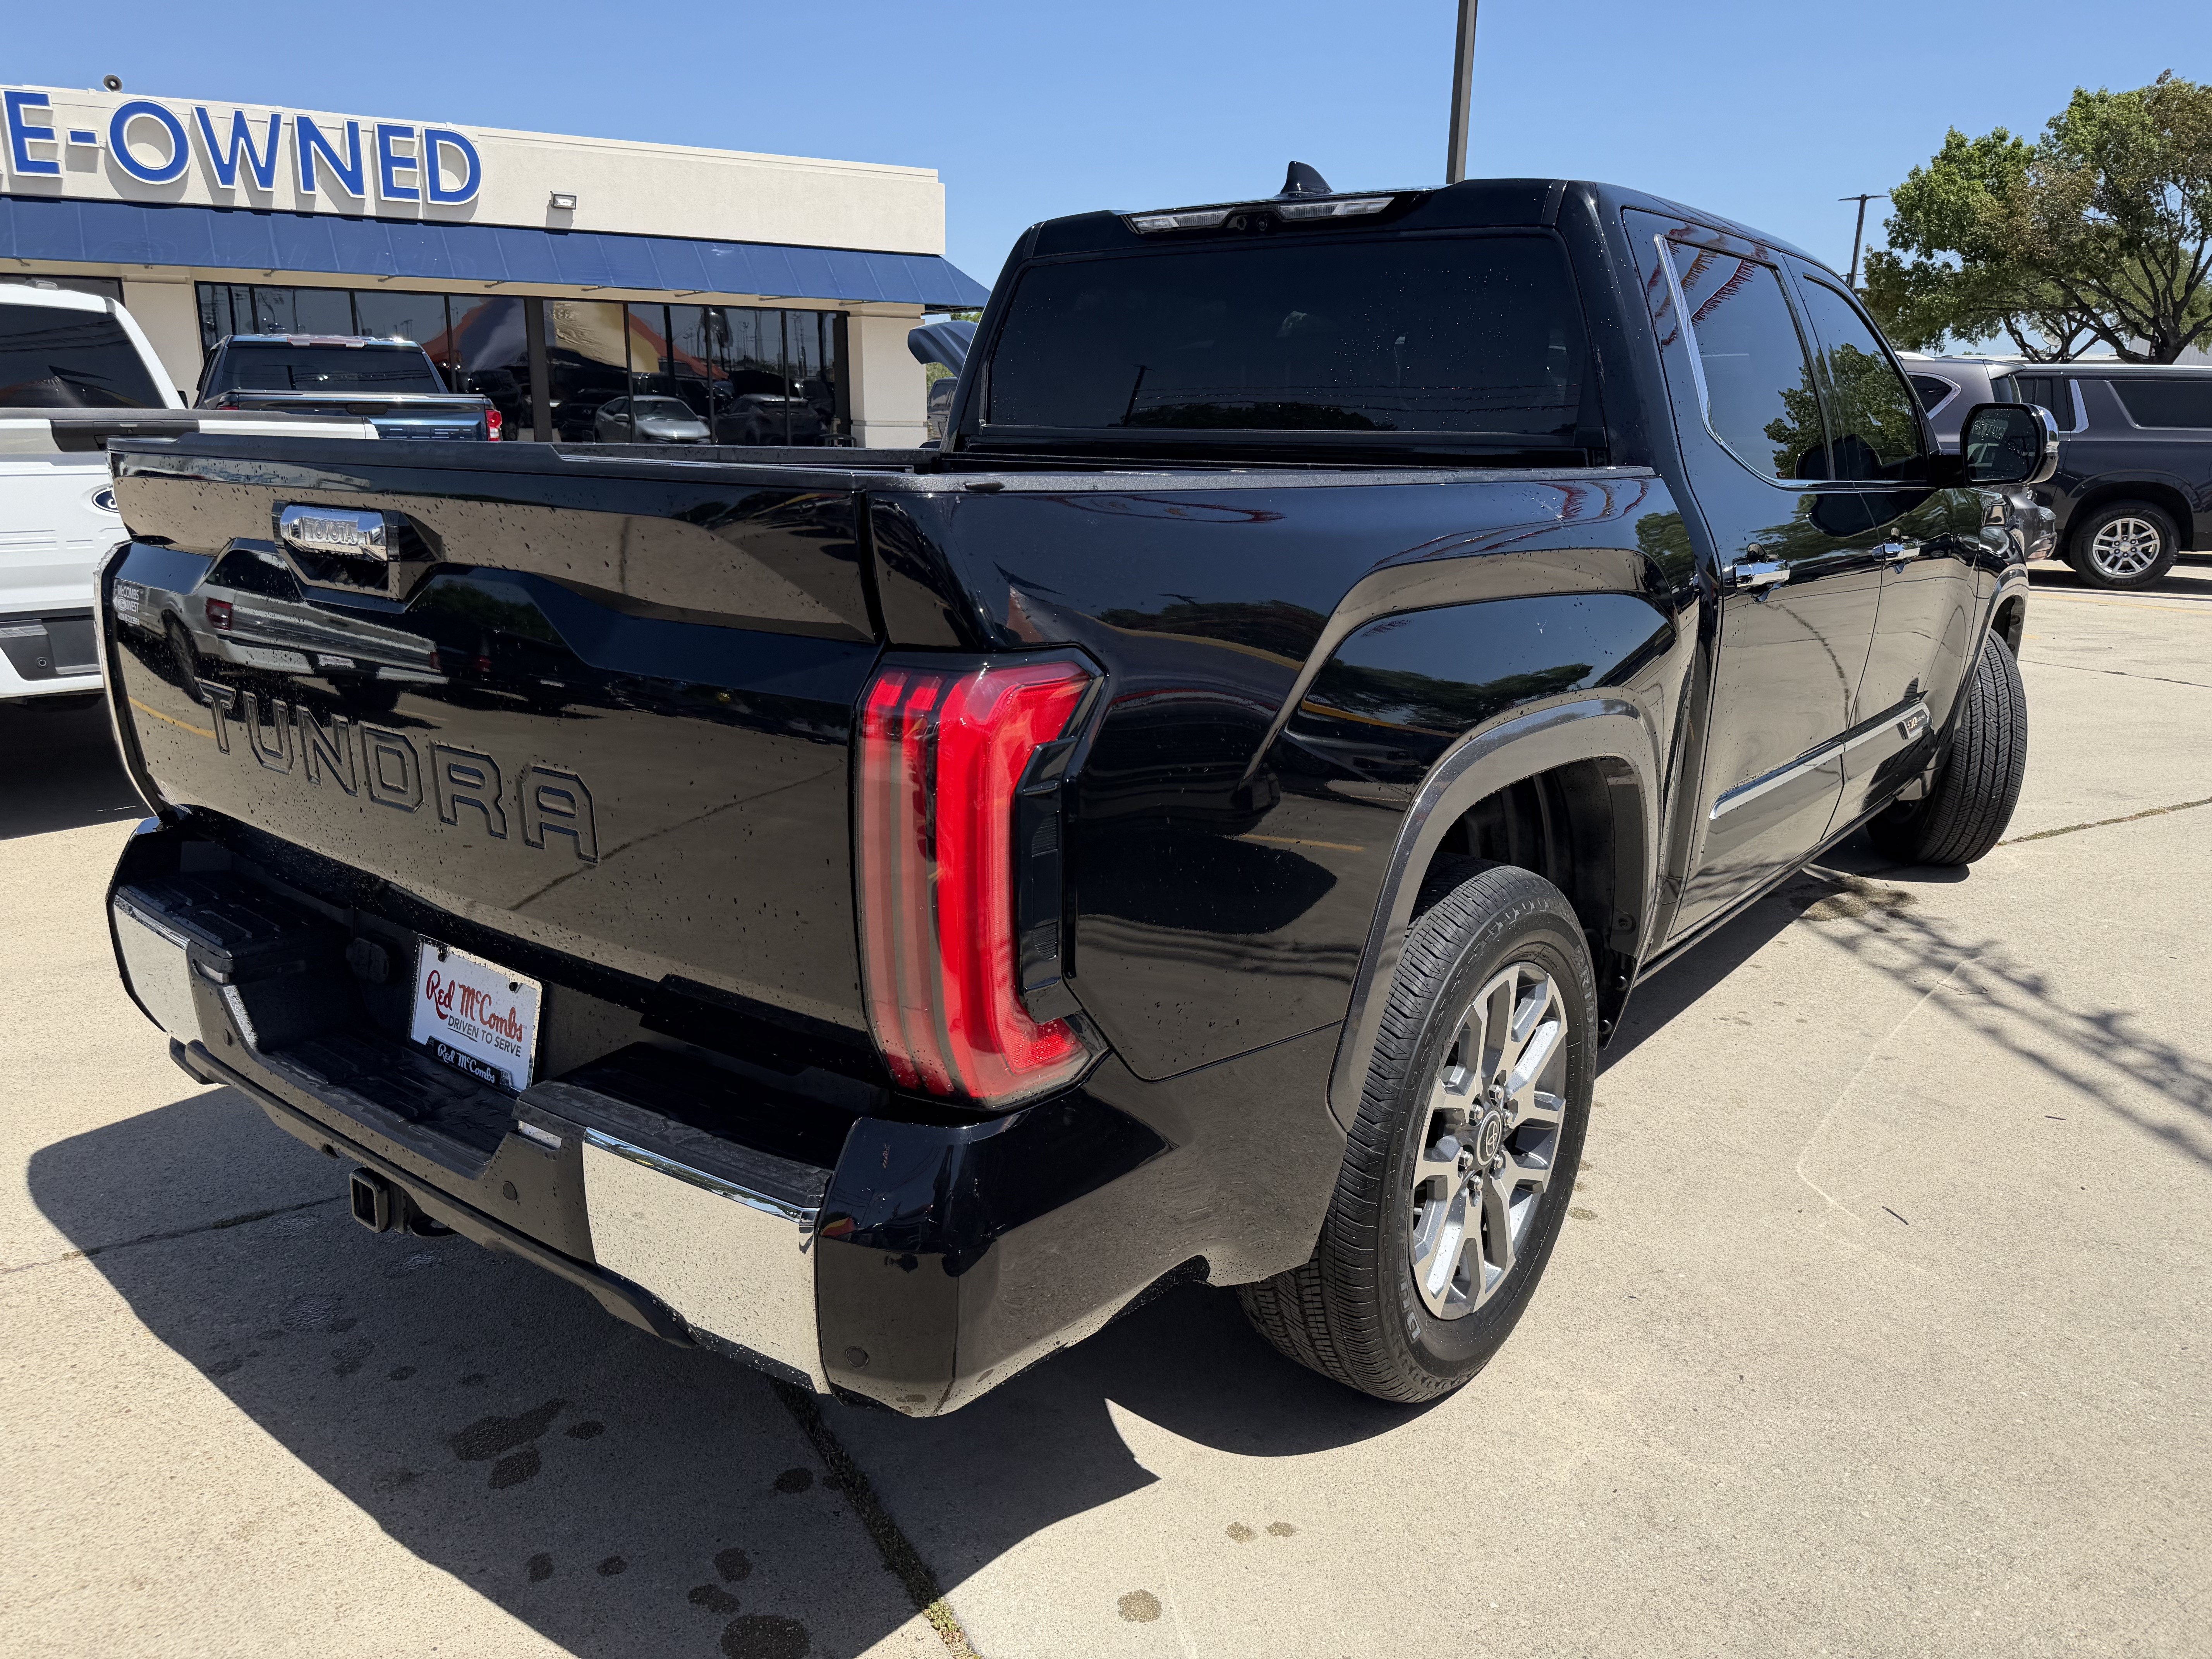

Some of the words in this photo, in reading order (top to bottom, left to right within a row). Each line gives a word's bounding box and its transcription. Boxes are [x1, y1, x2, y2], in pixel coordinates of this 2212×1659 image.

[0, 89, 483, 204] E-OWNED
[306, 520, 355, 543] TOYOTA
[193, 676, 600, 865] TUNDRA
[426, 970, 455, 1020] Red
[459, 981, 523, 1043] McCombs
[437, 1044, 455, 1063] Red
[456, 1051, 495, 1084] McCombs
[448, 1015, 479, 1039] DRIVEN
[482, 1029, 493, 1044] TO
[494, 1036, 522, 1058] SERVE
